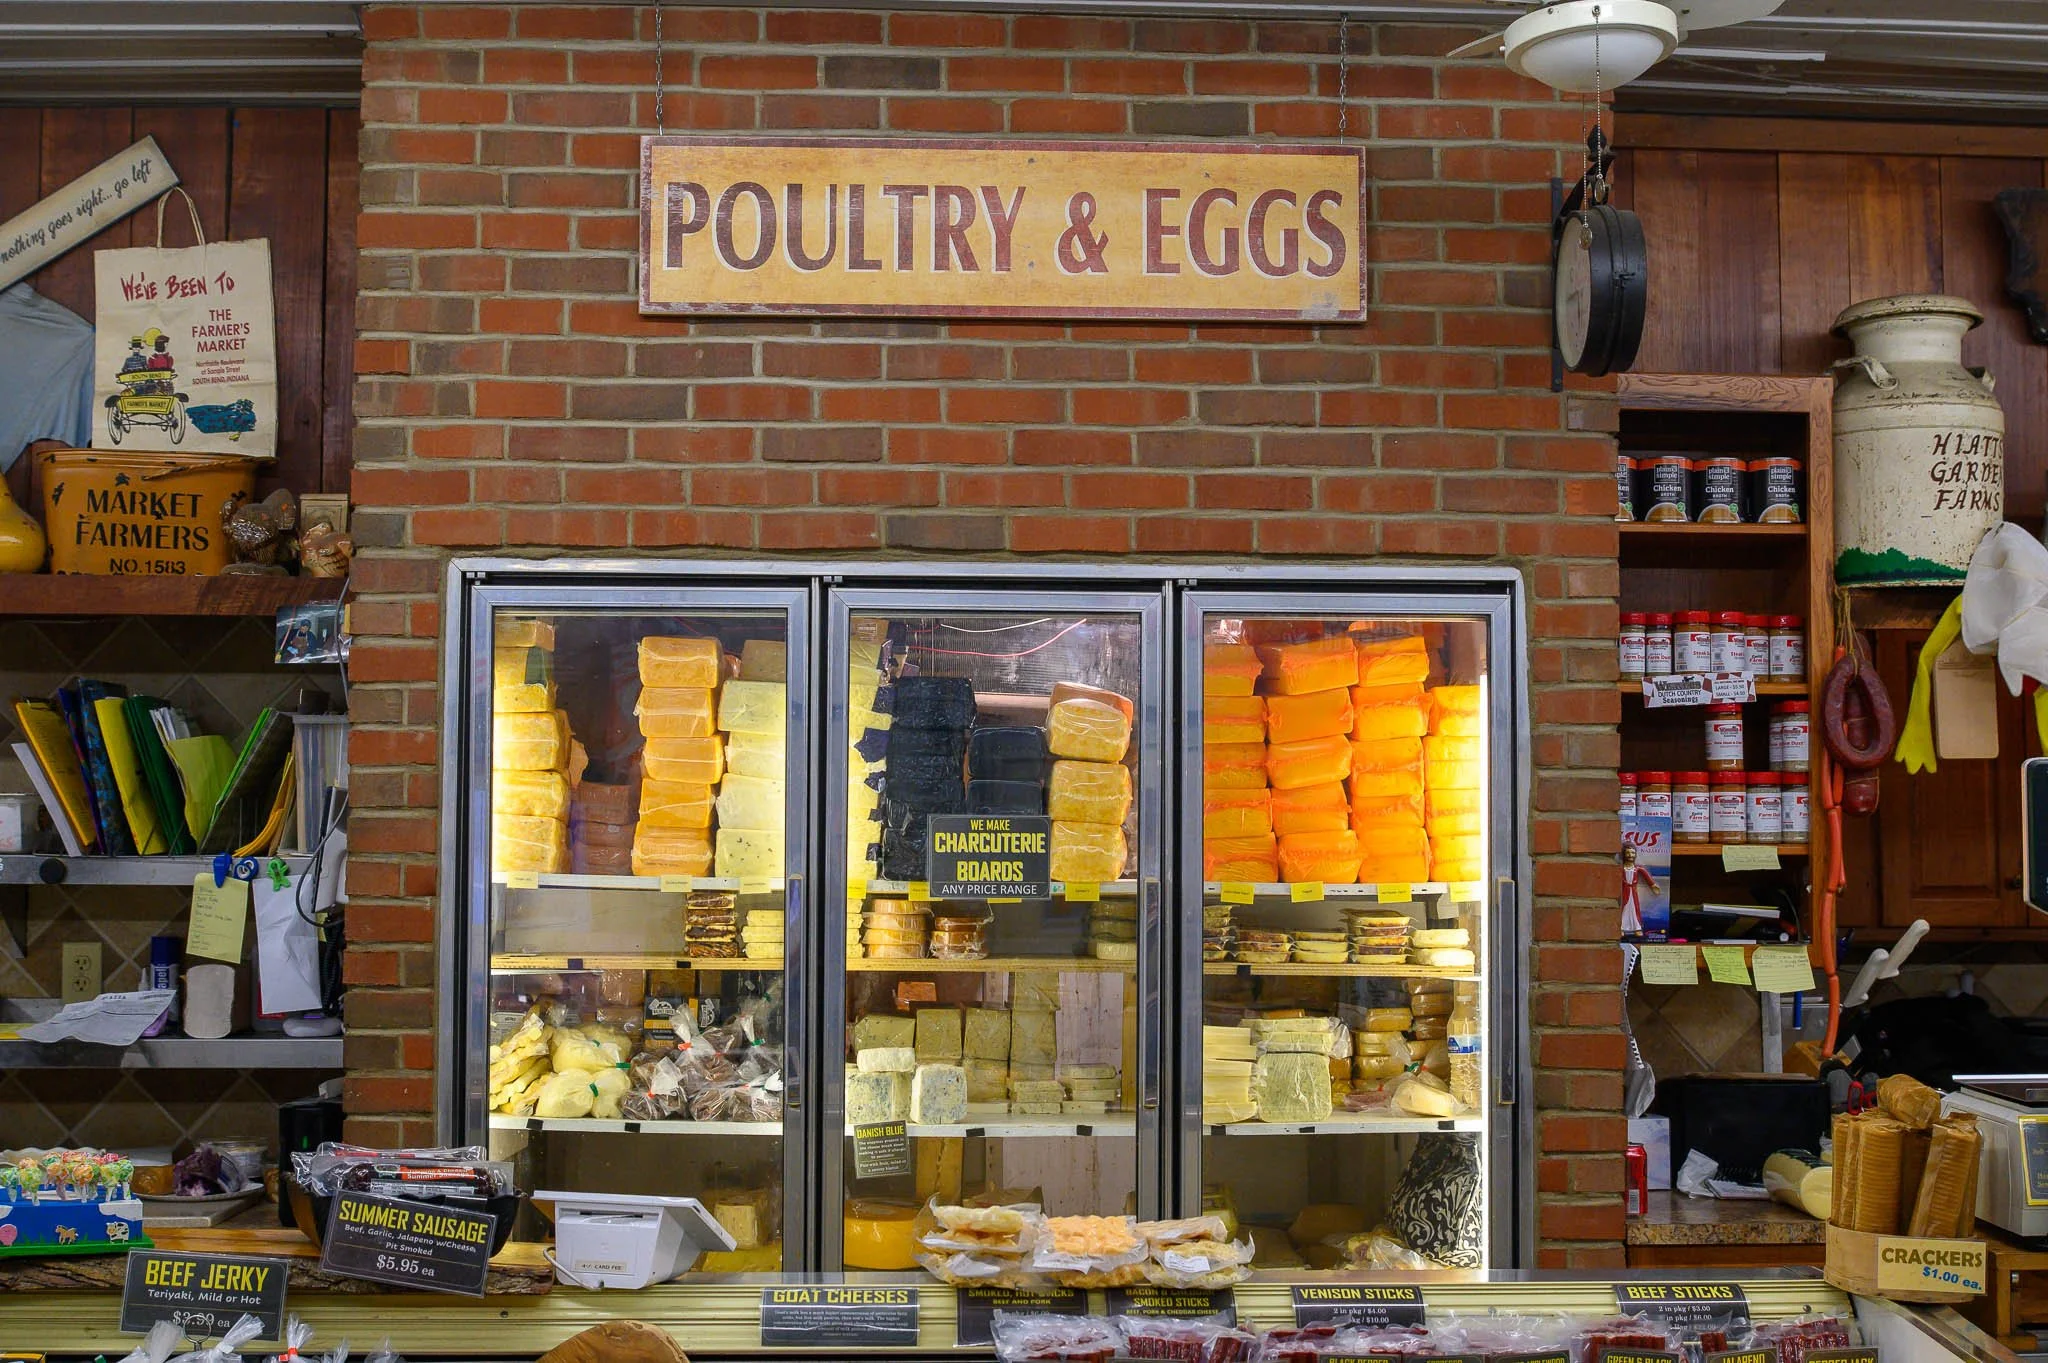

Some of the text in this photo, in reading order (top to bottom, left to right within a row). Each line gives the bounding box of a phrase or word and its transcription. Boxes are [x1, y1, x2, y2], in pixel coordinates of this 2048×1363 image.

[0, 228, 46, 263] nothing
[48, 212, 73, 239] goes
[114, 178, 129, 199] go
[132, 158, 152, 183] left
[662, 181, 1345, 280] POULTRY & EGGS
[120, 270, 235, 302] WE'VE BEEN TO
[209, 309, 232, 321] THE
[192, 323, 250, 338] FARMER'S
[197, 338, 246, 352] MARKET
[192, 377, 210, 385] SOUTH
[1931, 461, 2002, 487] GARDE
[1653, 484, 1682, 492] Chicken
[87, 489, 204, 518] MARKET
[1933, 489, 2000, 512] FARMS
[75, 520, 209, 551] FARMERS
[970, 819, 1010, 830] WE MAKE
[934, 832, 1046, 853] CHARCUTERIE
[956, 861, 1024, 882] BOARDS
[942, 885, 1038, 894] ANY PRICE RANGE
[856, 1126, 904, 1139] DANISH BLUE
[339, 1200, 488, 1243] SUMMER SAUSAGE
[344, 1224, 365, 1235] Beef,
[368, 1228, 395, 1239] Garlic,
[397, 1232, 434, 1245] Jalapeno
[386, 1242, 433, 1256] Pit Smoked
[1881, 1247, 1982, 1267] CRACKERS
[376, 1254, 435, 1277] $5.95 ea
[145, 1259, 269, 1292] BEEF JERKY
[1923, 1266, 1982, 1290] $1.00 ea.
[148, 1289, 261, 1304] Teriyaki, Mild or Hot
[773, 1289, 909, 1304] GOAT CHEESES
[1300, 1288, 1415, 1299] VENISON STICKS
[1626, 1286, 1734, 1299] BEEF STICKS
[1134, 1297, 1210, 1307] SMOKED STICKS
[217, 1319, 230, 1328] ea
[1675, 1314, 1688, 1322] pkg
[1607, 1355, 1635, 1363] GREEN
[1723, 1353, 1766, 1363] JALAPENO
